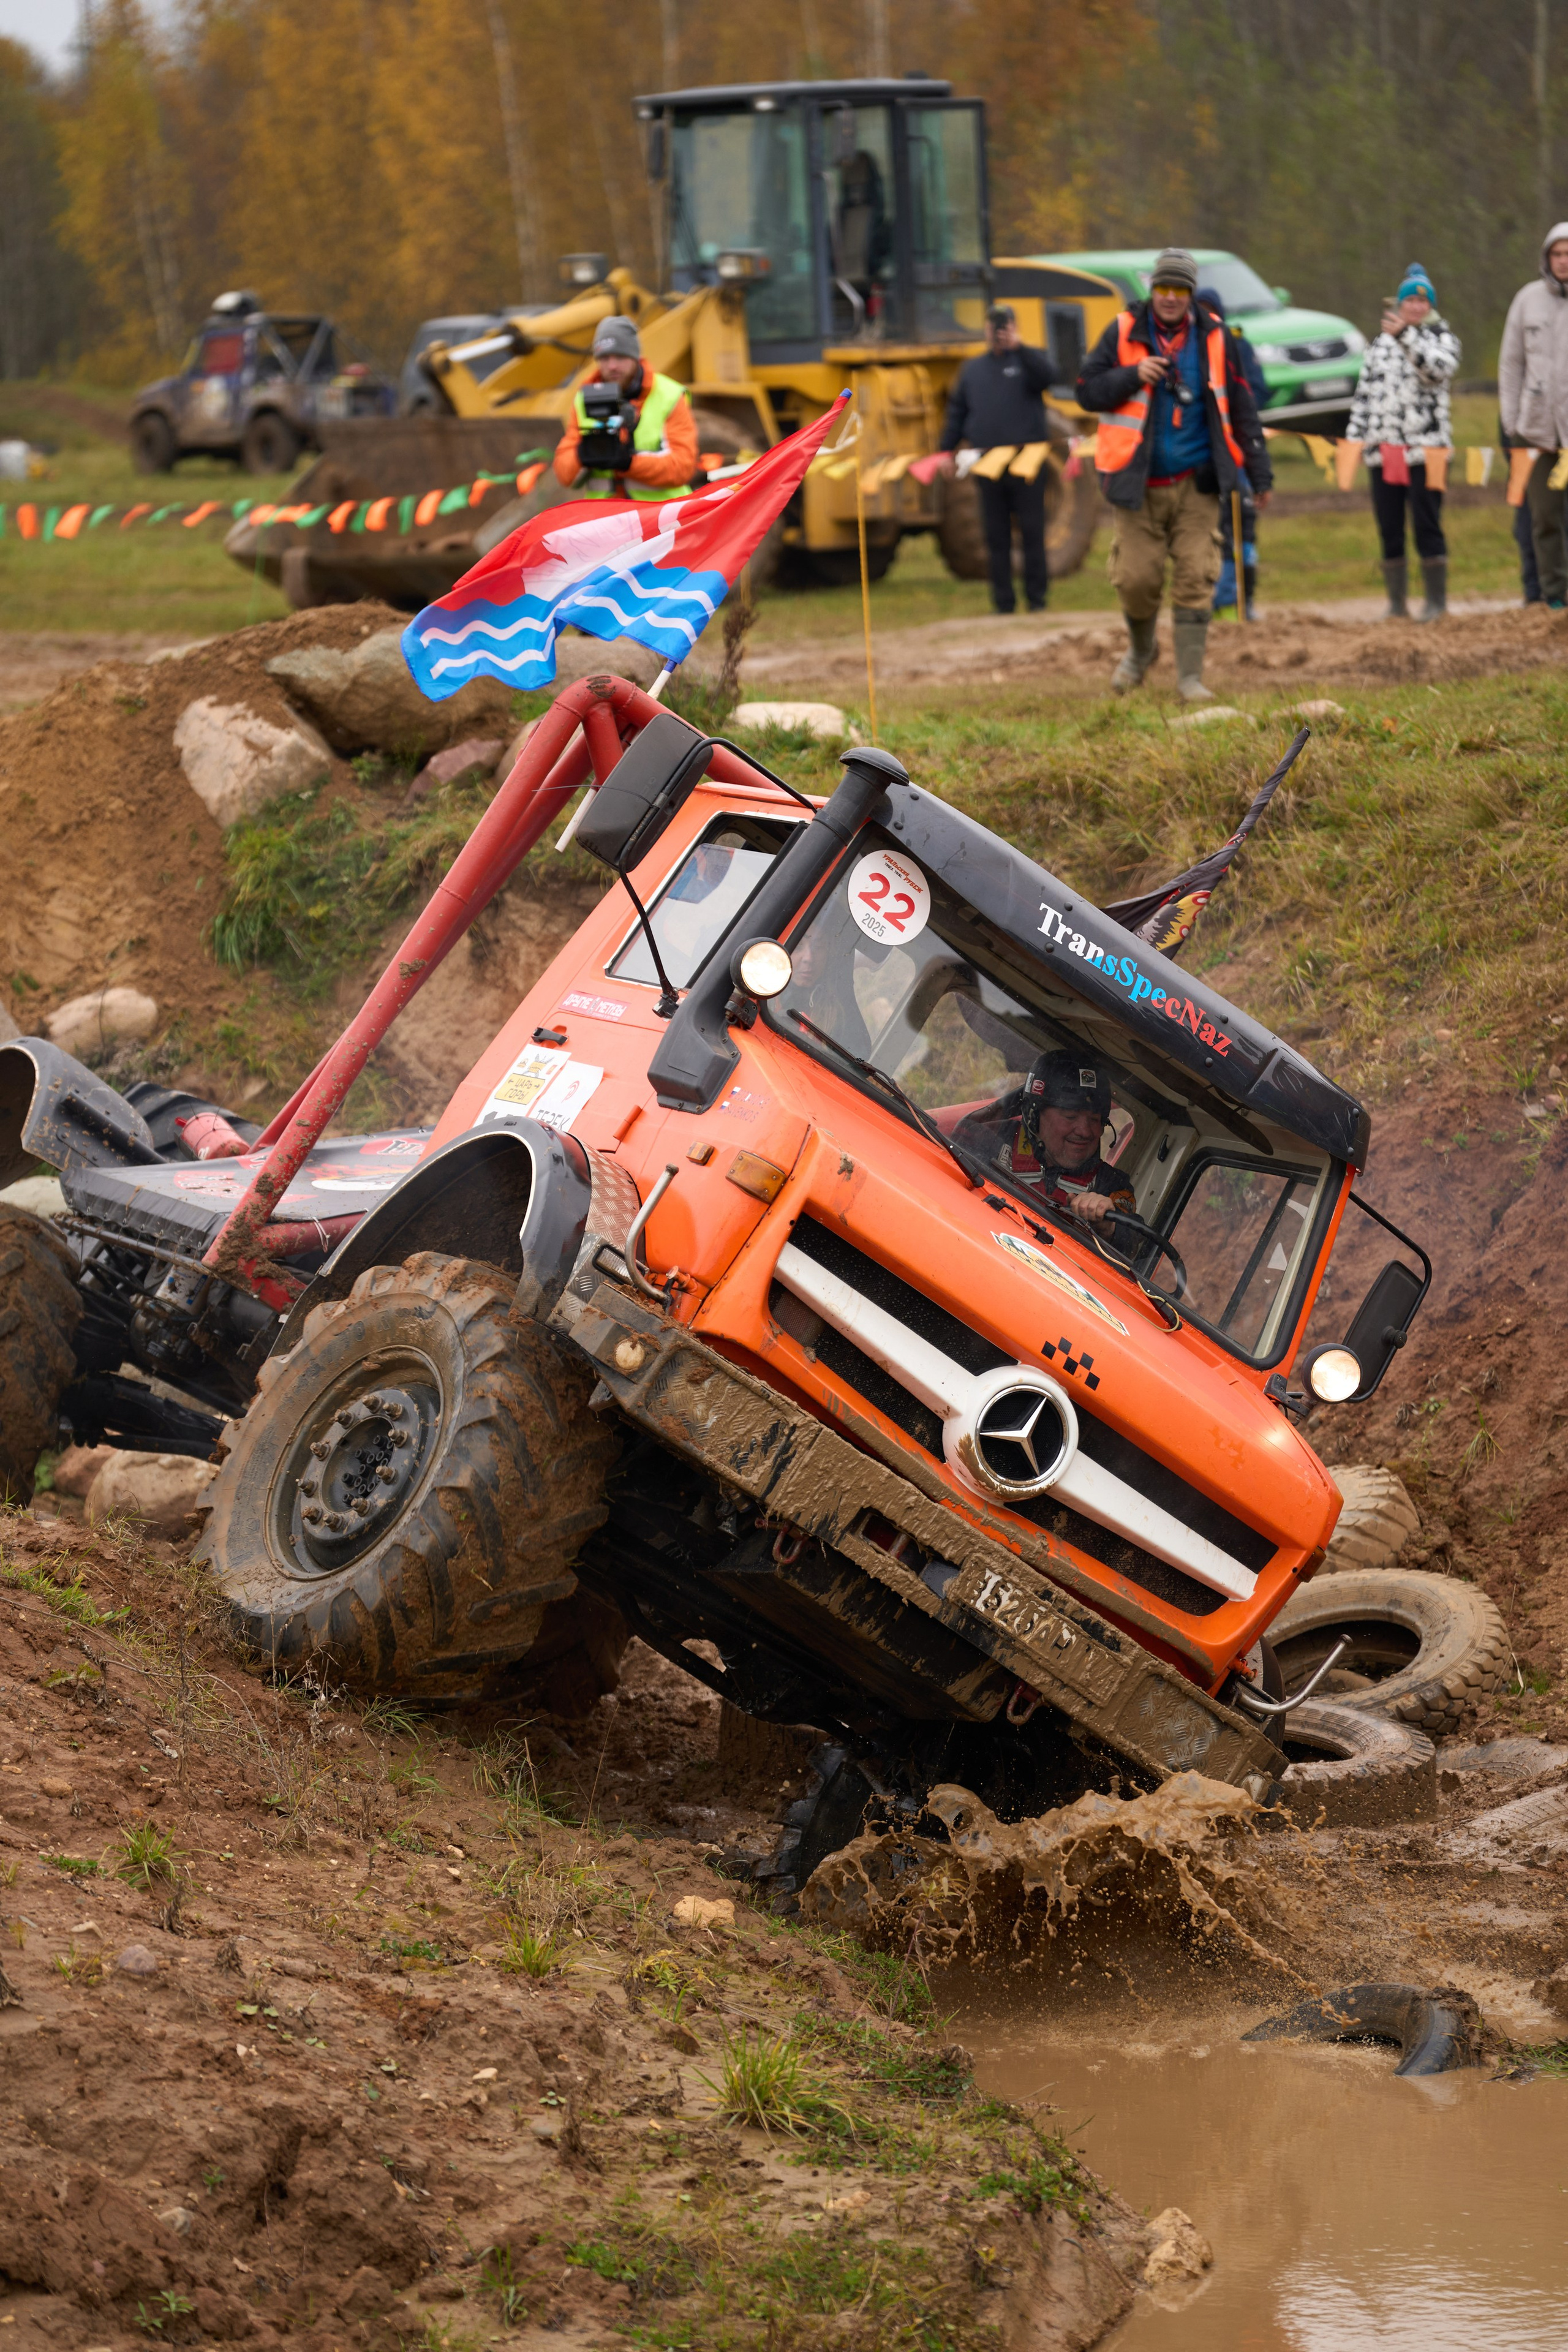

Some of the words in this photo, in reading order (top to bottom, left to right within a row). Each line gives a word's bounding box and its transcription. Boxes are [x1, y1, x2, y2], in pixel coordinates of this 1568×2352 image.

[884, 862, 894, 871] TRUCK
[903, 877, 923, 893] РУБЕЖ
[858, 872, 915, 933] 22
[861, 913, 886, 937] 2025
[1037, 902, 1232, 1057] TransSpecNaz
[514, 1078, 533, 1090] ЦАРЬ
[504, 1088, 529, 1101] ГОРЫ
